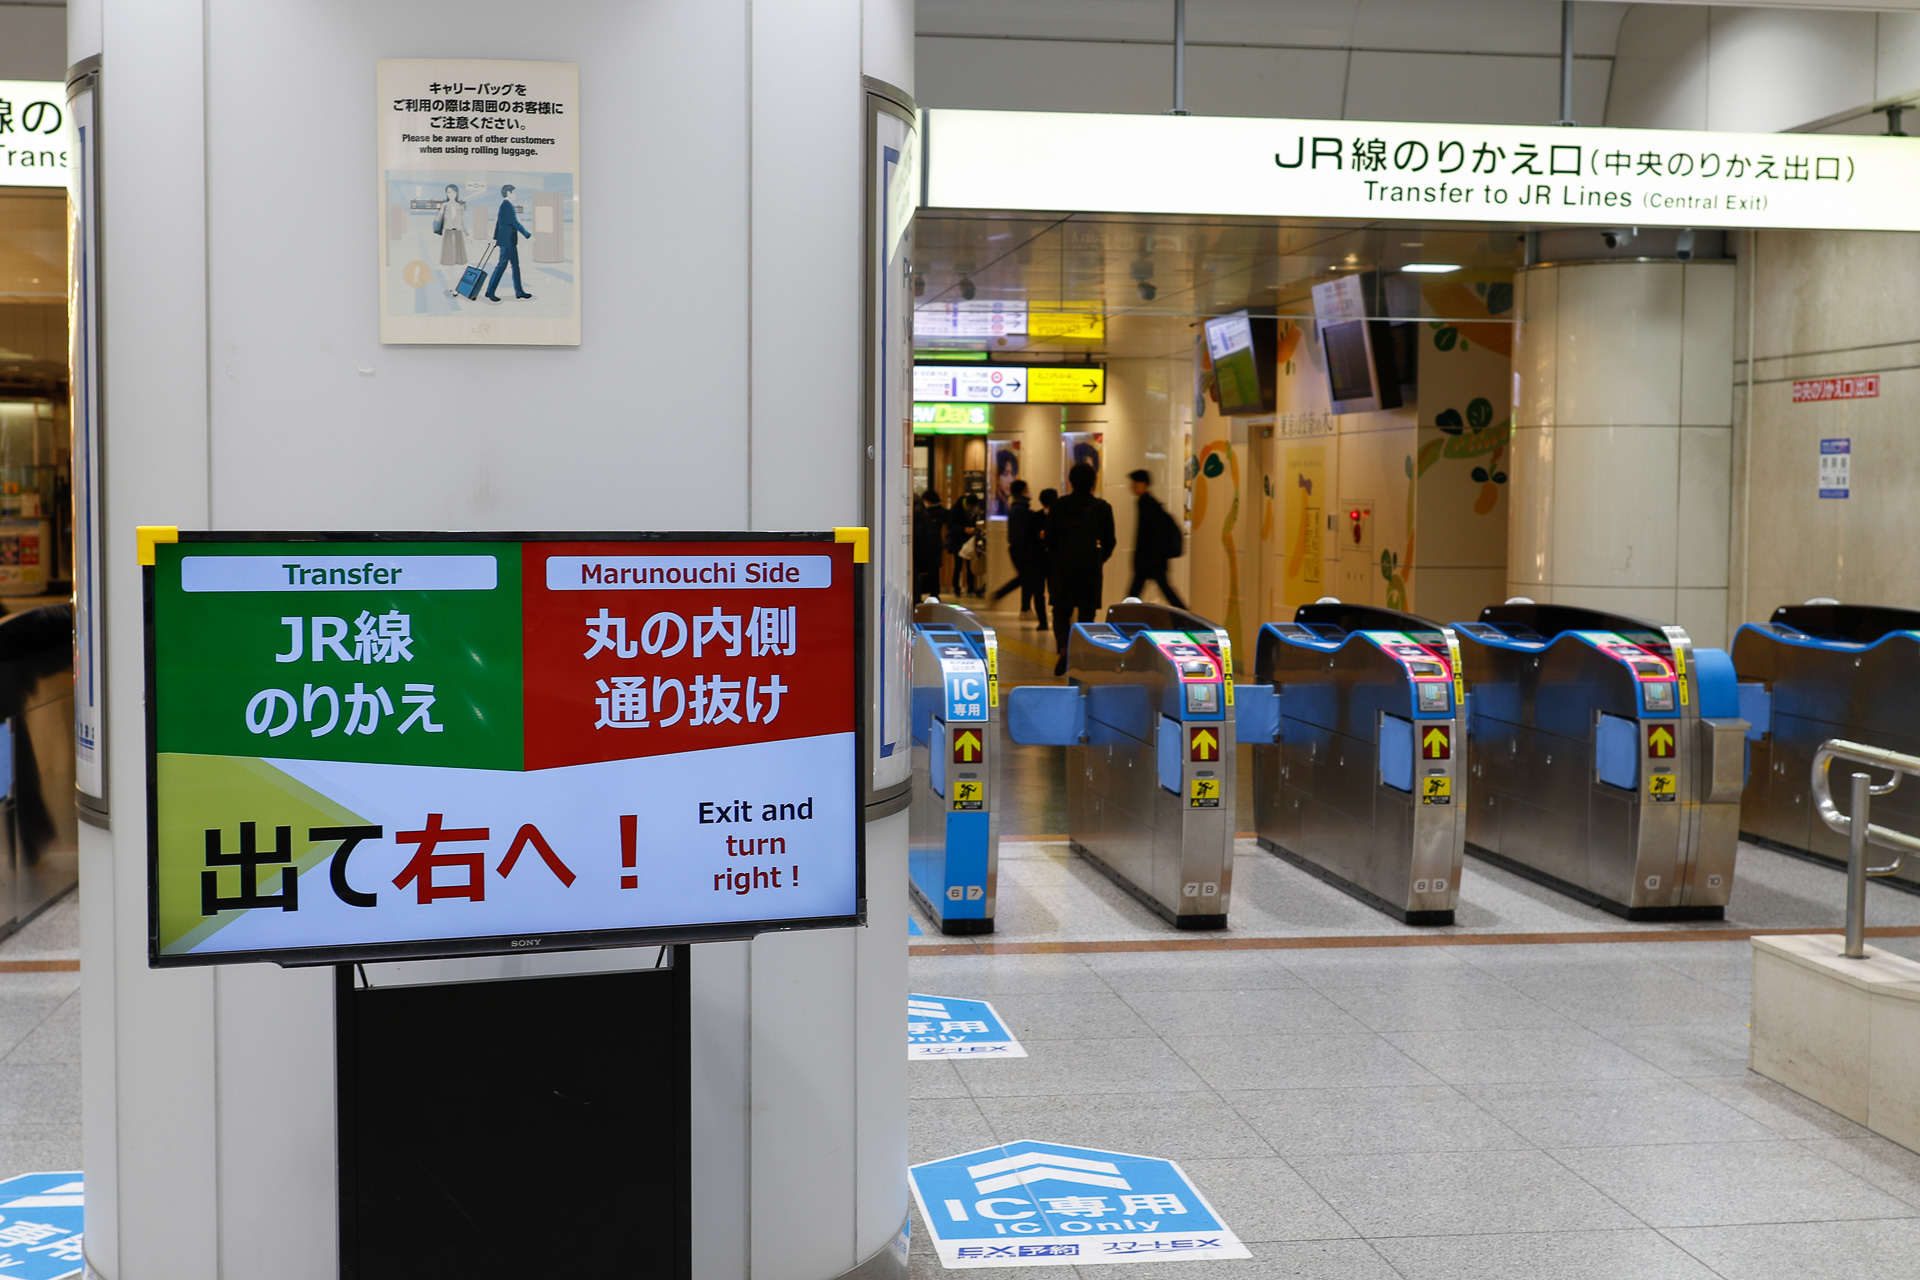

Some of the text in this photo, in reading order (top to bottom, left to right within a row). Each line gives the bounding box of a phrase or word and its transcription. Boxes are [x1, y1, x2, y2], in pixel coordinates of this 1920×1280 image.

[429, 82, 527, 96] キャリーバッグを
[393, 99, 564, 115] ご利用の際は周囲のお客様に
[430, 116, 526, 130] ご注意ください。
[402, 134, 430, 142] Please
[432, 134, 443, 142] be
[474, 134, 483, 143] of
[485, 135, 508, 143] other
[510, 136, 555, 145] customers
[419, 145, 538, 157] when using rolling luggage.
[1364, 181, 1767, 211] Transfer to JR Lines (Central Exit)
[282, 563, 402, 585] Transfer
[581, 562, 800, 585] Marunouchi Side
[275, 610, 414, 664] JR線
[583, 606, 797, 660] 丸の内側
[953, 678, 980, 701] IC
[594, 674, 788, 730] 通り抜け
[245, 682, 444, 738] のりかえ
[953, 703, 980, 716] 専用
[699, 797, 813, 824] Exit and
[726, 835, 786, 857] turn
[201, 813, 637, 916] 出て右へ！
[1187, 885, 1196, 894] 7
[1205, 885, 1214, 894] 8
[1417, 881, 1426, 890] 8
[1435, 881, 1444, 890] 9
[951, 889, 960, 898] 6
[970, 888, 979, 898] 7
[511, 938, 542, 947] SONY
[944, 1193, 1188, 1222] IC専用
[994, 1220, 1160, 1234] IC Only
[1103, 1238, 1222, 1252] スマートEX
